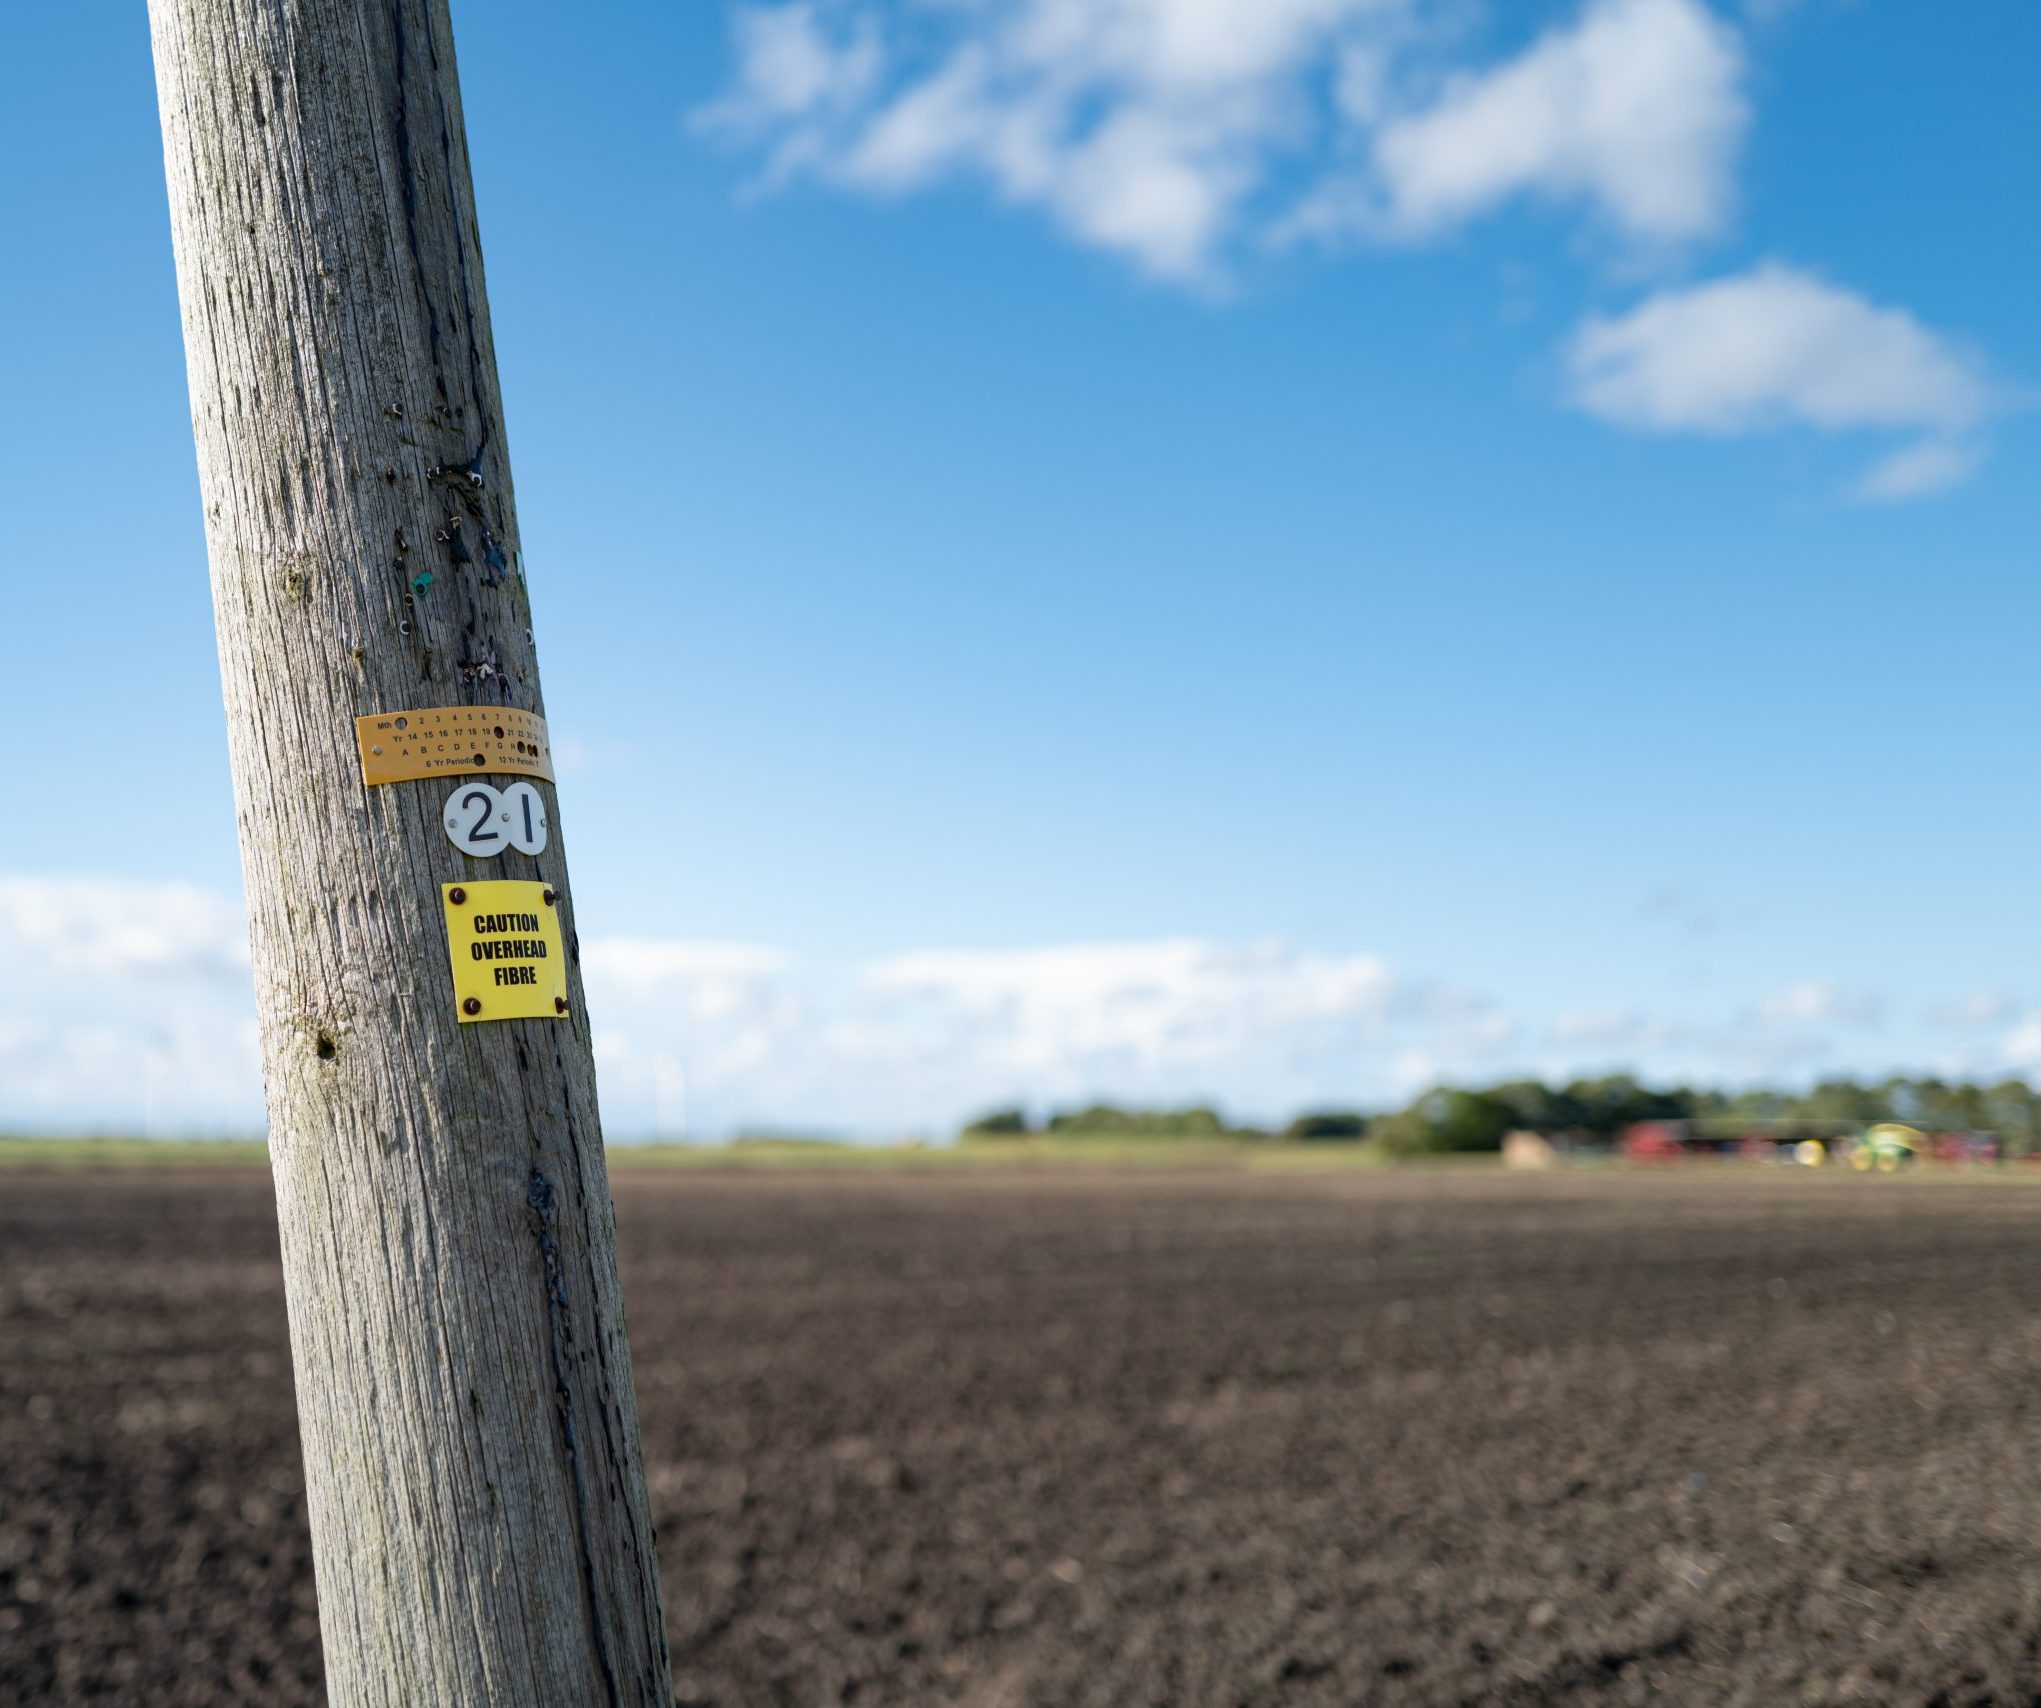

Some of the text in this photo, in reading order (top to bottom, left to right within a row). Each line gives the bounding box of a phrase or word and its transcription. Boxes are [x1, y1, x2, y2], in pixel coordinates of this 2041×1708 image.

[377, 722, 392, 730] Mth
[419, 717, 424, 725] 2
[435, 715, 441, 723] 3
[452, 714, 457, 722] 4
[467, 713, 472, 721] 5
[495, 713, 501, 721] 7
[393, 735, 402, 743] Yr
[408, 733, 418, 741] 14
[424, 731, 434, 739] 15
[439, 730, 448, 738] 16
[454, 728, 463, 736] 17
[468, 728, 477, 736] 18
[482, 728, 491, 736] 19
[421, 746, 427, 754] B
[437, 744, 444, 752] C
[454, 743, 460, 751] D
[470, 742, 476, 750] E
[484, 742, 490, 750] F
[497, 742, 503, 750] G
[426, 760, 432, 768] 6
[434, 759, 444, 767] Yr
[473, 913, 539, 934] CAUTION
[470, 940, 547, 961] OVERHEAD
[493, 966, 537, 987] FIBRE
